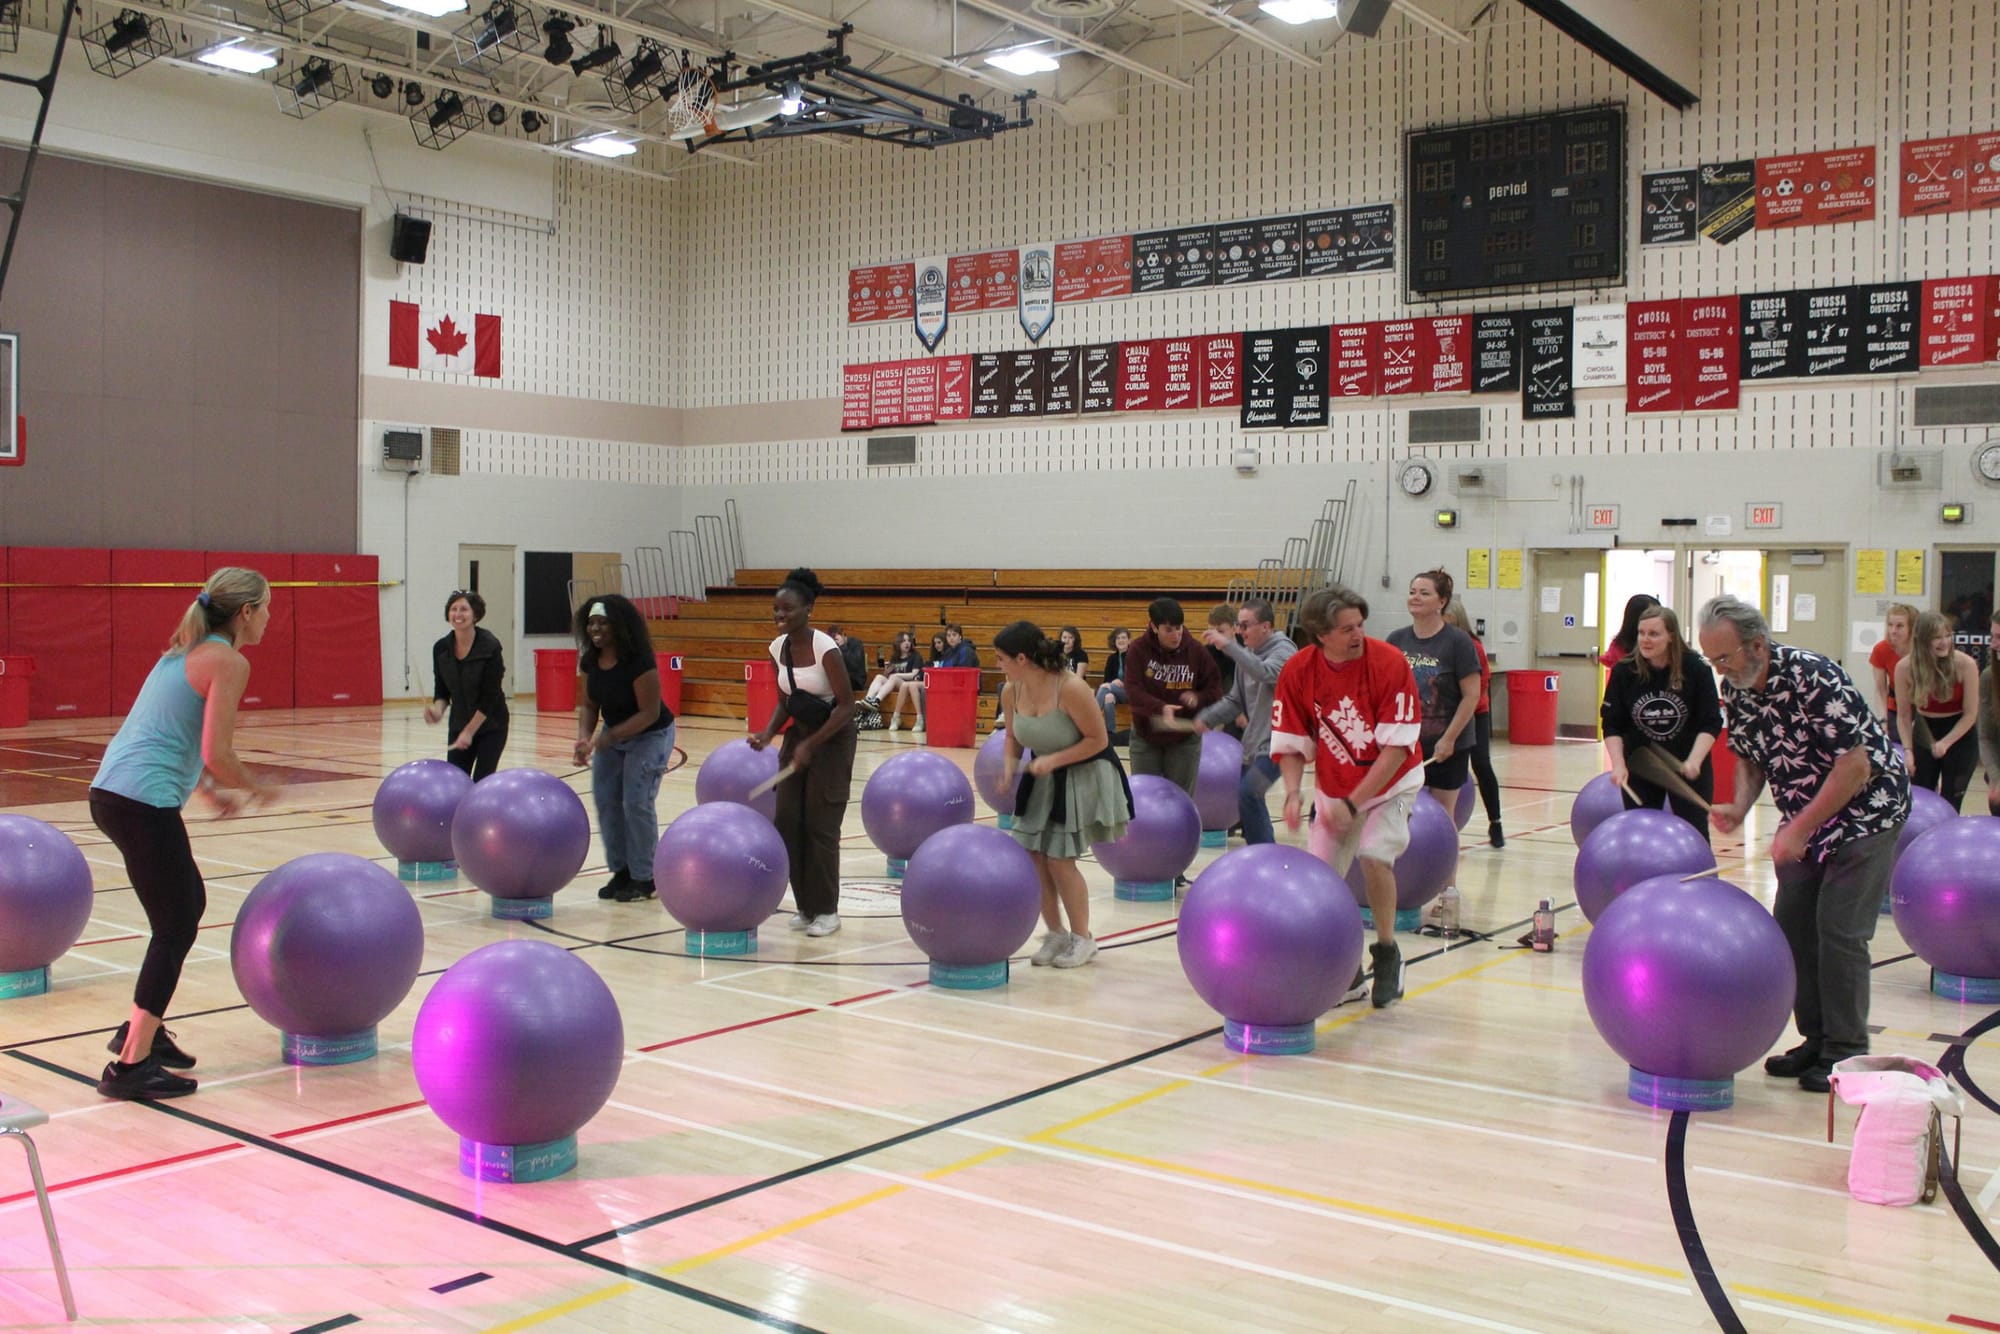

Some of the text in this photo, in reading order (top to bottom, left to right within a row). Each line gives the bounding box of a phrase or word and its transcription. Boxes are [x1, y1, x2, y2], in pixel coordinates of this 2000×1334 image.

[1653, 177, 1686, 186] CWOSSA
[1489, 181, 1528, 200] period
[1914, 191, 1951, 200] HOCKEY
[1818, 199, 1871, 209] BASKETBALL
[1769, 206, 1802, 215] SOCCER
[1659, 215, 1678, 223] BOYS
[1653, 222, 1684, 231] HOCKEY
[1260, 260, 1297, 269] VOLLEYBALL
[1305, 255, 1343, 264] BASKETBALL
[1176, 269, 1211, 277] VOLLEYBALL
[1218, 267, 1254, 275] VOLLEYBALL
[1934, 285, 1973, 298] CWOSSA
[1810, 295, 1847, 308] CWOSSA
[1870, 290, 1908, 304] CWOSSA
[1751, 298, 1786, 310] CWOSSA
[1870, 304, 1909, 314] DISTRICT 4
[1933, 299, 1973, 310] DISTRICT 4
[1693, 306, 1726, 321] CWOSSA
[1750, 309, 1787, 319] DISTRICT 4
[1809, 307, 1847, 318] DISTRICT 4
[1433, 318, 1462, 328] CWOSSA
[1481, 318, 1512, 328] CWOSSA
[1532, 318, 1563, 328] CWOSSA
[1638, 311, 1670, 326] CWOSSA
[1339, 328, 1367, 337] CWOSSA
[1385, 323, 1414, 333] CWOSSA
[1436, 328, 1454, 336] DISTRICT
[1478, 328, 1515, 338] DISTRICT 4
[1686, 326, 1733, 338] DISTRICT 4
[1634, 330, 1675, 340] DISTRICT 4
[1486, 341, 1507, 350] 94-95
[1532, 336, 1564, 346] DISTRICT
[1773, 340, 1788, 348] BOYS
[1538, 345, 1558, 355] 4/10
[1867, 341, 1910, 352] GIRLS SOCCER
[1751, 348, 1786, 358] BASKETBALL
[1932, 345, 1970, 364] Champions
[1481, 360, 1511, 369] BASKETBALL
[1809, 356, 1845, 374] Champions
[1869, 352, 1907, 371] Champions
[1385, 366, 1414, 376] HOCKEY
[1644, 363, 1665, 373] BOYS
[1702, 365, 1723, 373] GIRLS
[1751, 359, 1786, 377] Champions
[1130, 373, 1145, 382] GIRLS
[1171, 373, 1186, 382] BOYS
[1340, 370, 1367, 386] Champions
[1433, 370, 1462, 379] BASKETBALL
[1480, 371, 1510, 387] Champions
[1638, 374, 1671, 385] CURLING
[1699, 373, 1727, 382] SOCCER
[1125, 382, 1149, 391] CURLING
[1165, 383, 1190, 392] CURLING
[1210, 381, 1233, 391] HOCKEY
[1385, 377, 1412, 393] Champions
[1434, 378, 1463, 392] Champions
[1528, 385, 1538, 393] 94
[1559, 382, 1568, 391] 95
[1250, 400, 1274, 409] HOCKEY
[1533, 403, 1564, 412] HOCKEY
[1247, 411, 1277, 424] Champions
[1290, 410, 1321, 423] Champions
[1594, 509, 1613, 525] EXIT
[1752, 507, 1775, 525] EXIT
